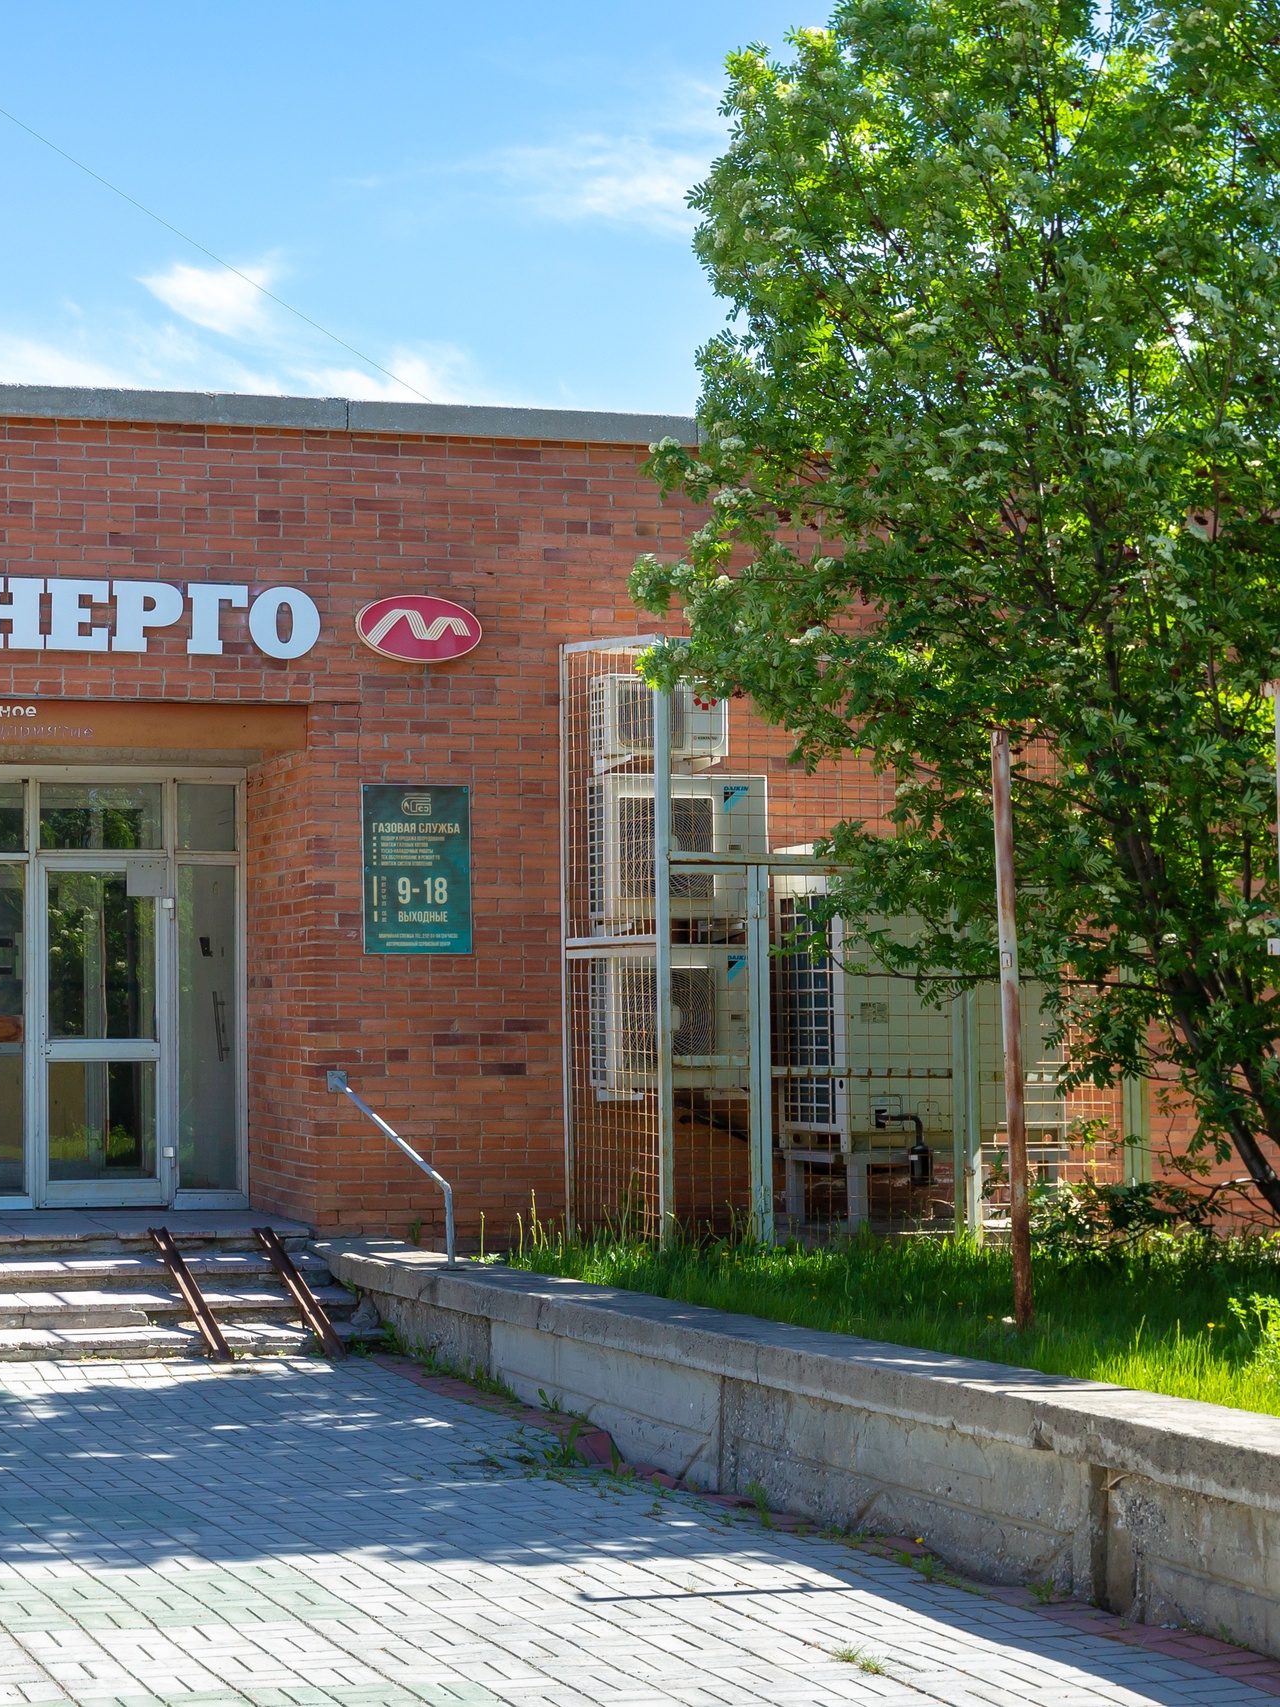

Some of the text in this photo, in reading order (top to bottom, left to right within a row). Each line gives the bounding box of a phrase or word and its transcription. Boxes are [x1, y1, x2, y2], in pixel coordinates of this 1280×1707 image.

[372, 822, 461, 834] ГАЗОВАЯ СЛУЖБА
[397, 876, 448, 904] 9-18
[398, 911, 448, 923] ВЫХОДНЫЕ
